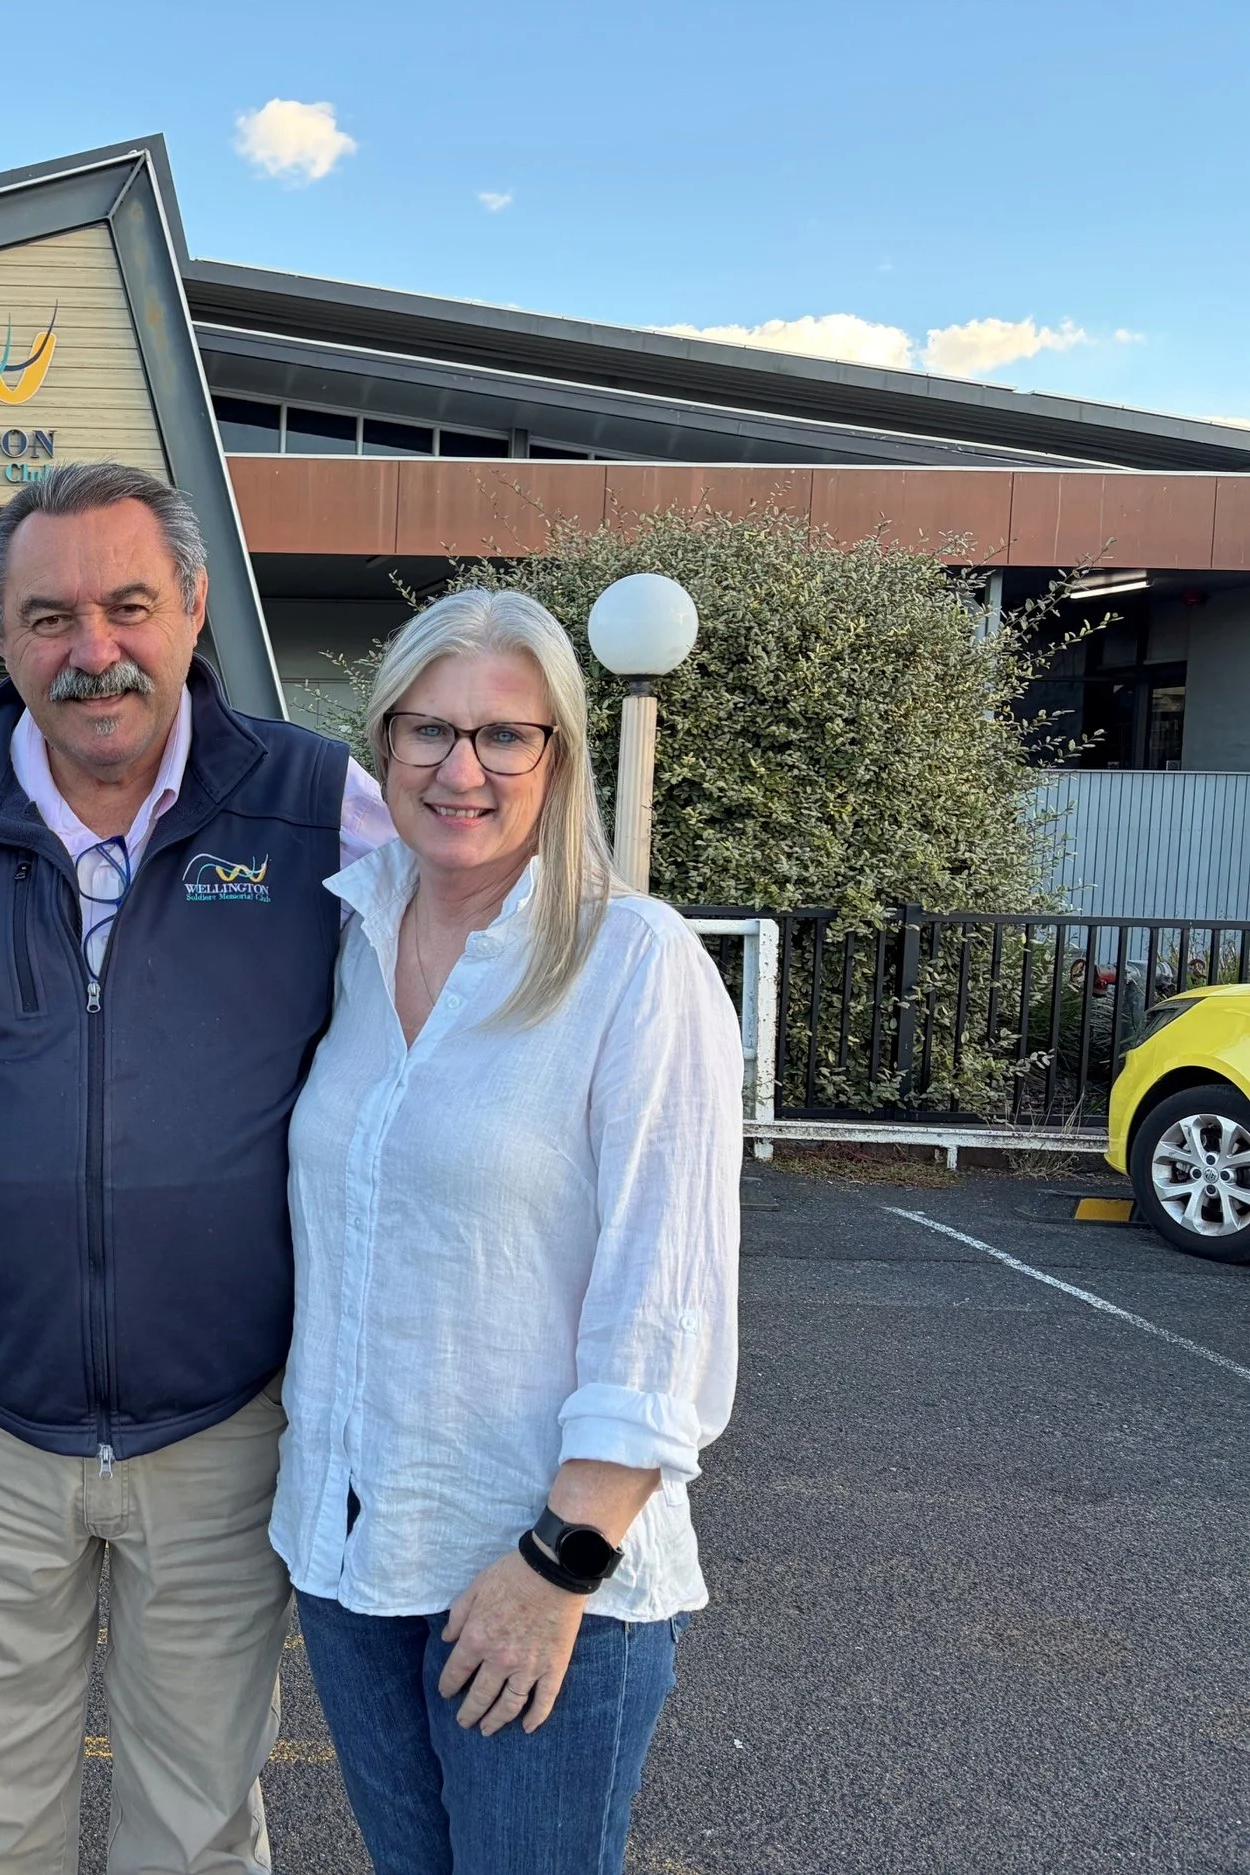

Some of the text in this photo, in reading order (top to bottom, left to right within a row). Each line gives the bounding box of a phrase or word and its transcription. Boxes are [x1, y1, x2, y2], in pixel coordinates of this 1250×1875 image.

[184, 882, 270, 896] WELLINGTON
[186, 893, 217, 902] Soldiers
[219, 892, 254, 901] Memorial
